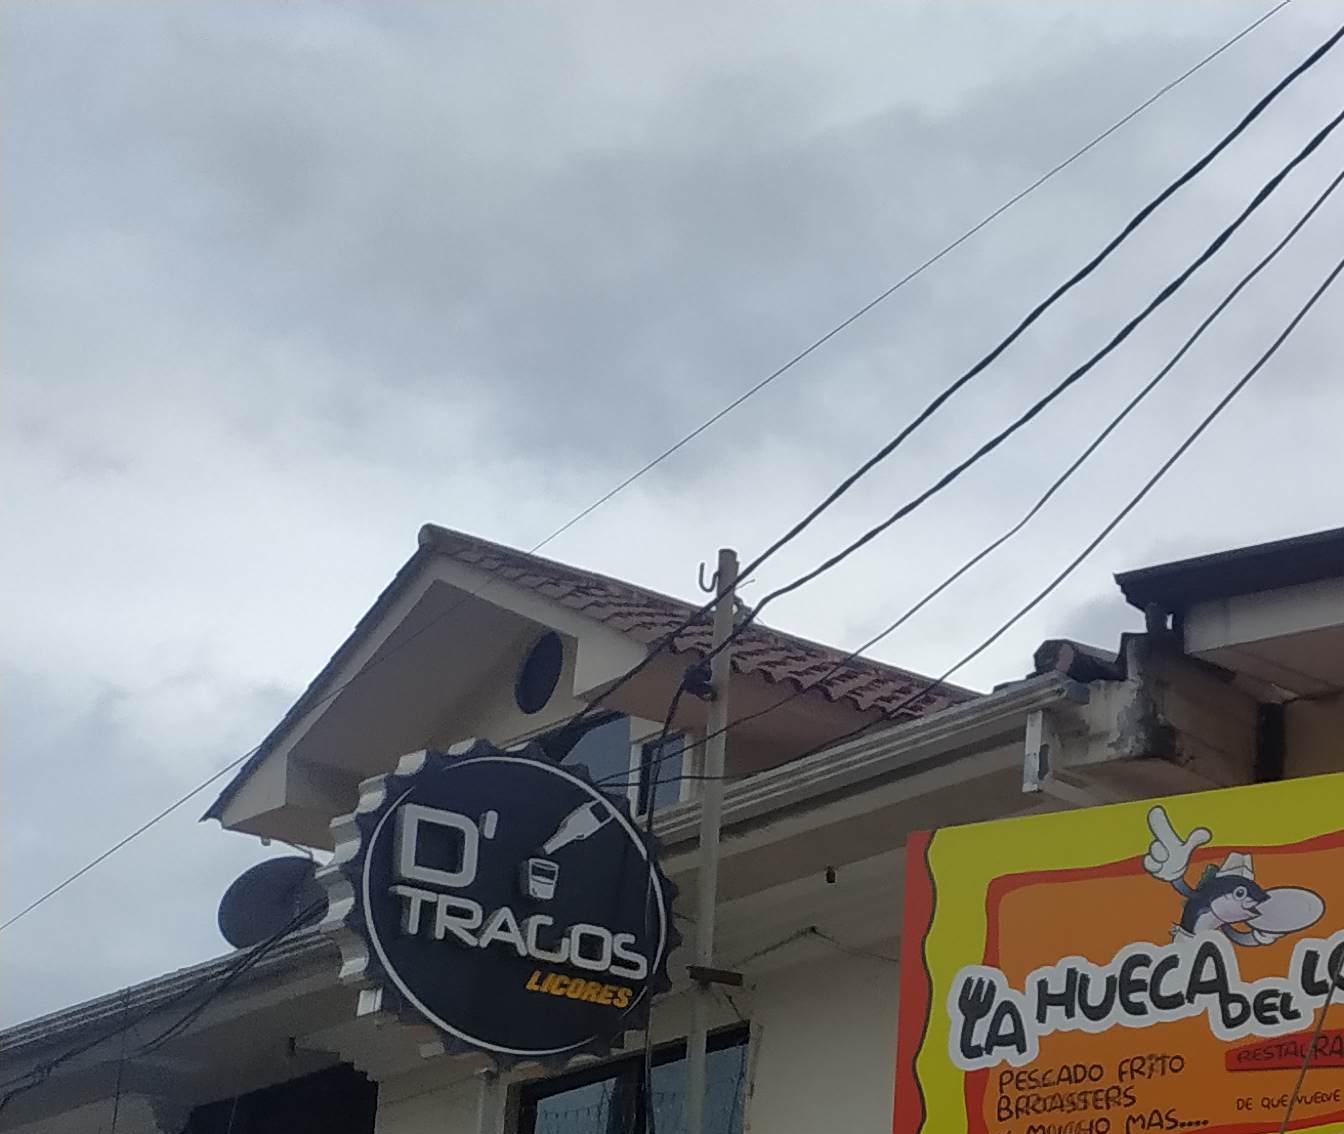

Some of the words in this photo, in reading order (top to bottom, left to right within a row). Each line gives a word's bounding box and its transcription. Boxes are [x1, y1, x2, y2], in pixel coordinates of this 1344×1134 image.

[389, 885, 648, 980] TRAGOS
[526, 970, 634, 1009] LICORES
[958, 976, 1028, 1060] LA
[1036, 941, 1229, 1024] HUECA
[1221, 988, 1301, 1029] DEL
[999, 1064, 1104, 1094] PESCADO
[1118, 1054, 1185, 1083] FRITO
[1236, 1098, 1253, 1111] DE
[1261, 1094, 1289, 1109] QUE
